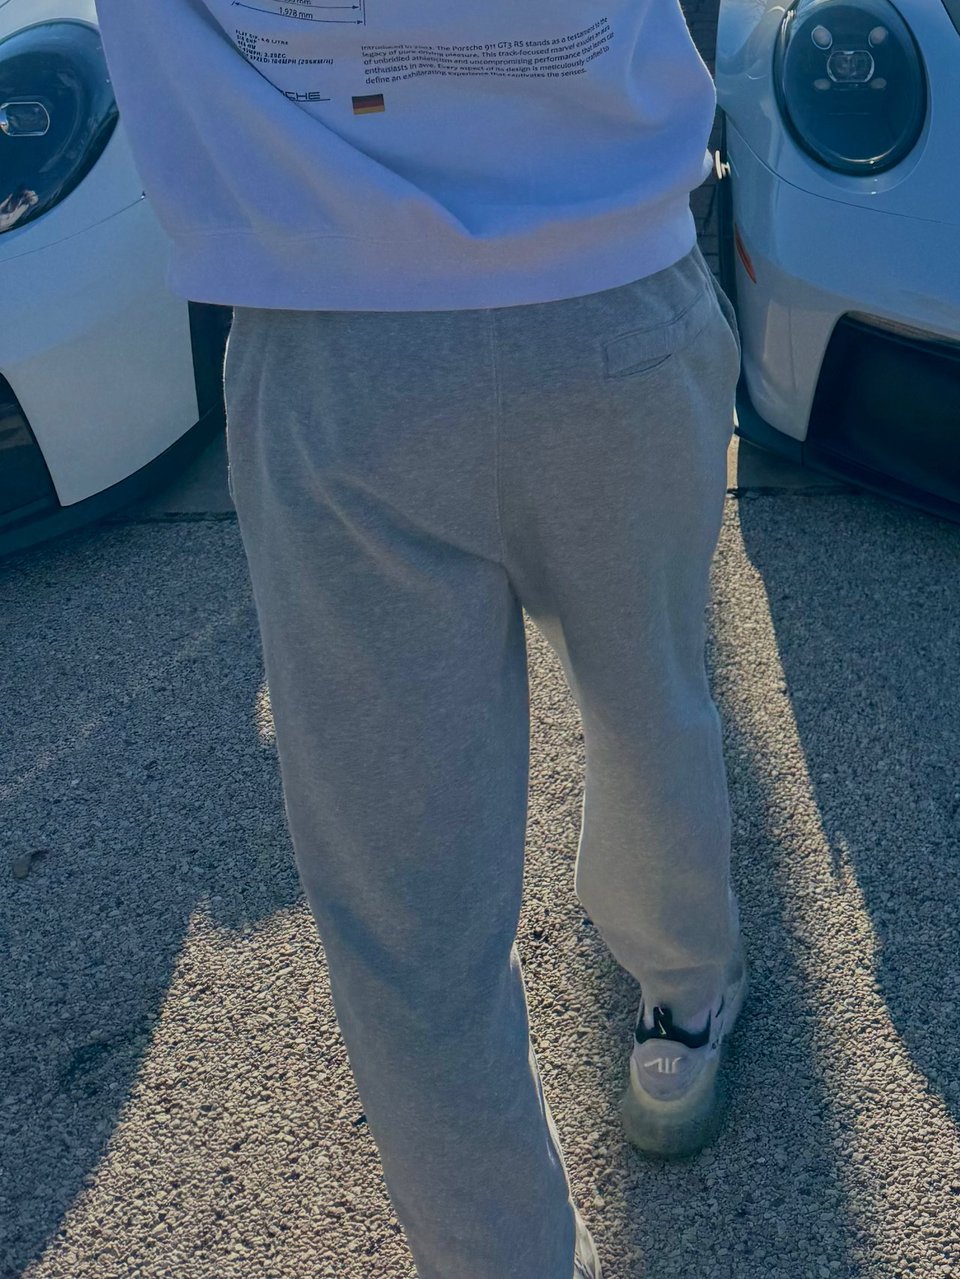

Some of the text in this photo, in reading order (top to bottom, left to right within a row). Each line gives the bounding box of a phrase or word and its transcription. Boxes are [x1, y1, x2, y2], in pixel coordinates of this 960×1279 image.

[298, 11, 314, 21] mm
[484, 43, 496, 51] 911
[497, 40, 513, 50] GT3
[513, 40, 524, 48] RS
[525, 38, 551, 47] stands
[551, 37, 560, 45] as
[550, 42, 575, 54] marvel
[363, 58, 372, 66] of
[534, 51, 581, 65] performance
[364, 64, 409, 75] enthusiasts
[365, 75, 391, 85] define
[391, 74, 402, 82] an
